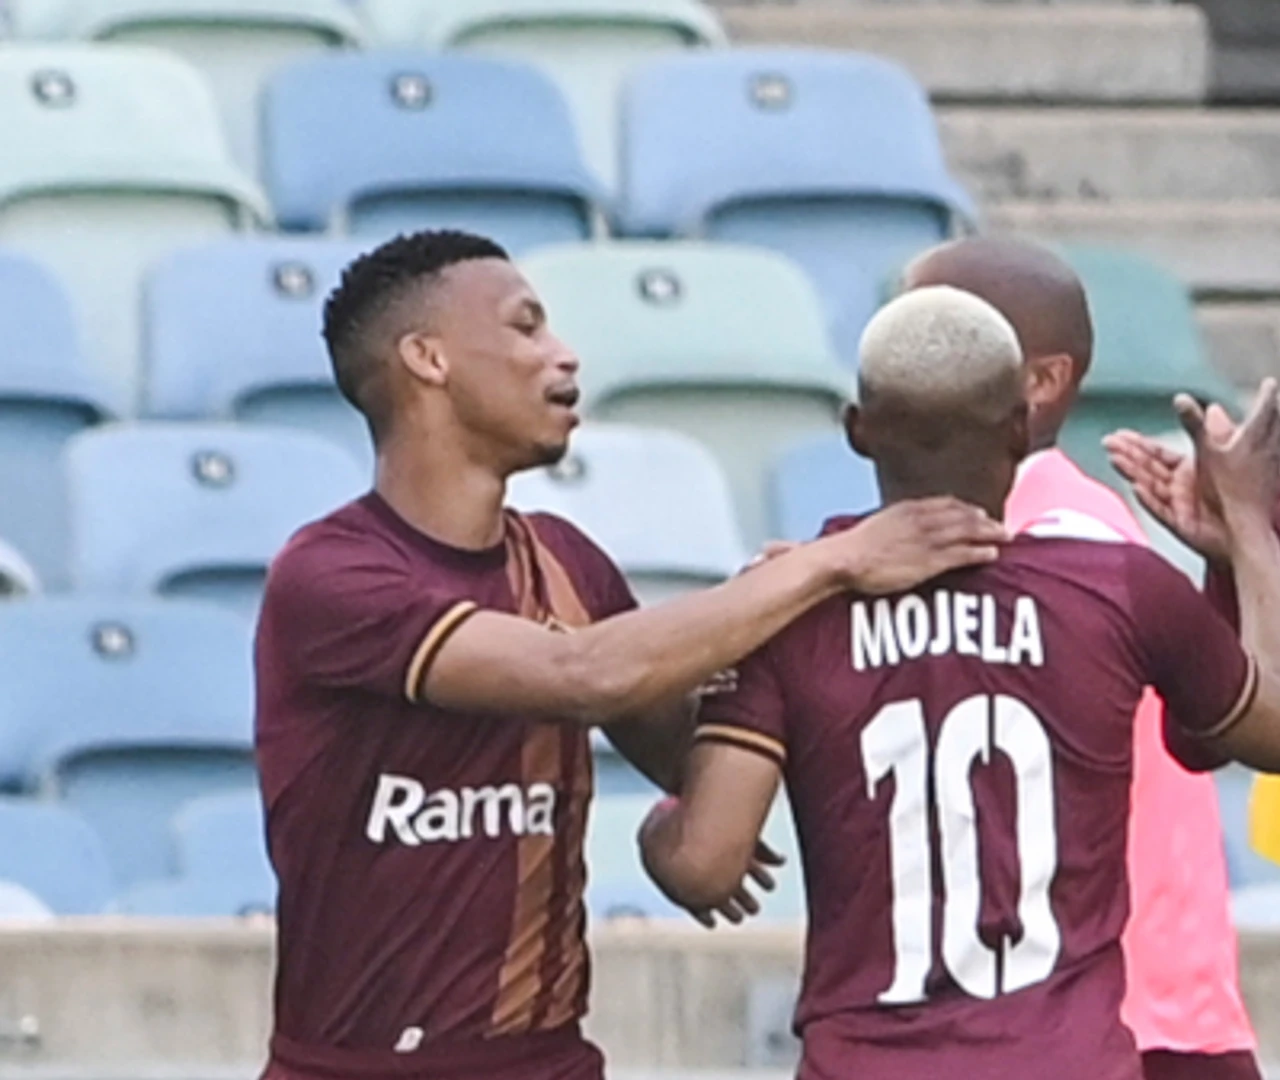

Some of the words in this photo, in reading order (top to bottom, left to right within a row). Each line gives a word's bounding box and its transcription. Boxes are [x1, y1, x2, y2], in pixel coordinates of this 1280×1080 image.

[851, 590, 1044, 671] MOJELA
[367, 773, 555, 846] Rama
[860, 694, 1061, 1003] 10
